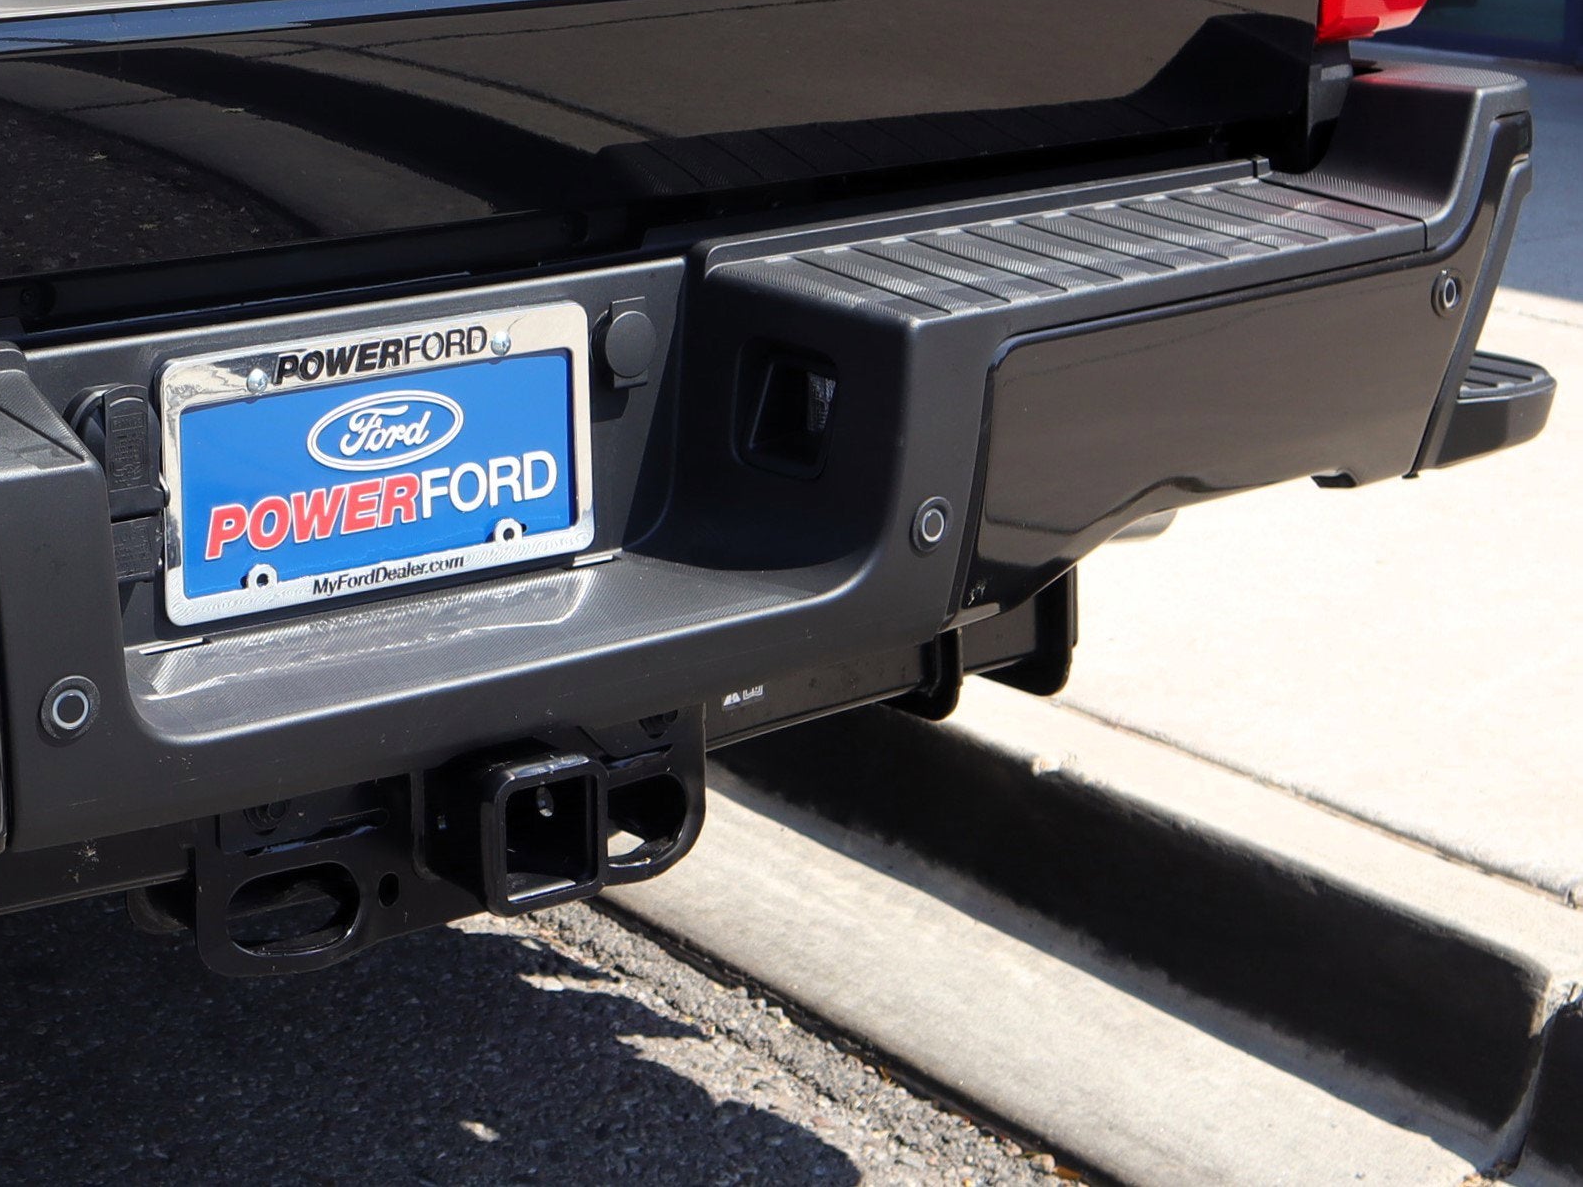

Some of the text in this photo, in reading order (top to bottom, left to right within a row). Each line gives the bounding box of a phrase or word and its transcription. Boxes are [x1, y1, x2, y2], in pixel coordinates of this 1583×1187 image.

[271, 325, 488, 386] POWERFORD
[339, 404, 432, 457] Ford
[204, 450, 558, 562] POWERFORD
[312, 556, 465, 597] MyFordDealer.com
